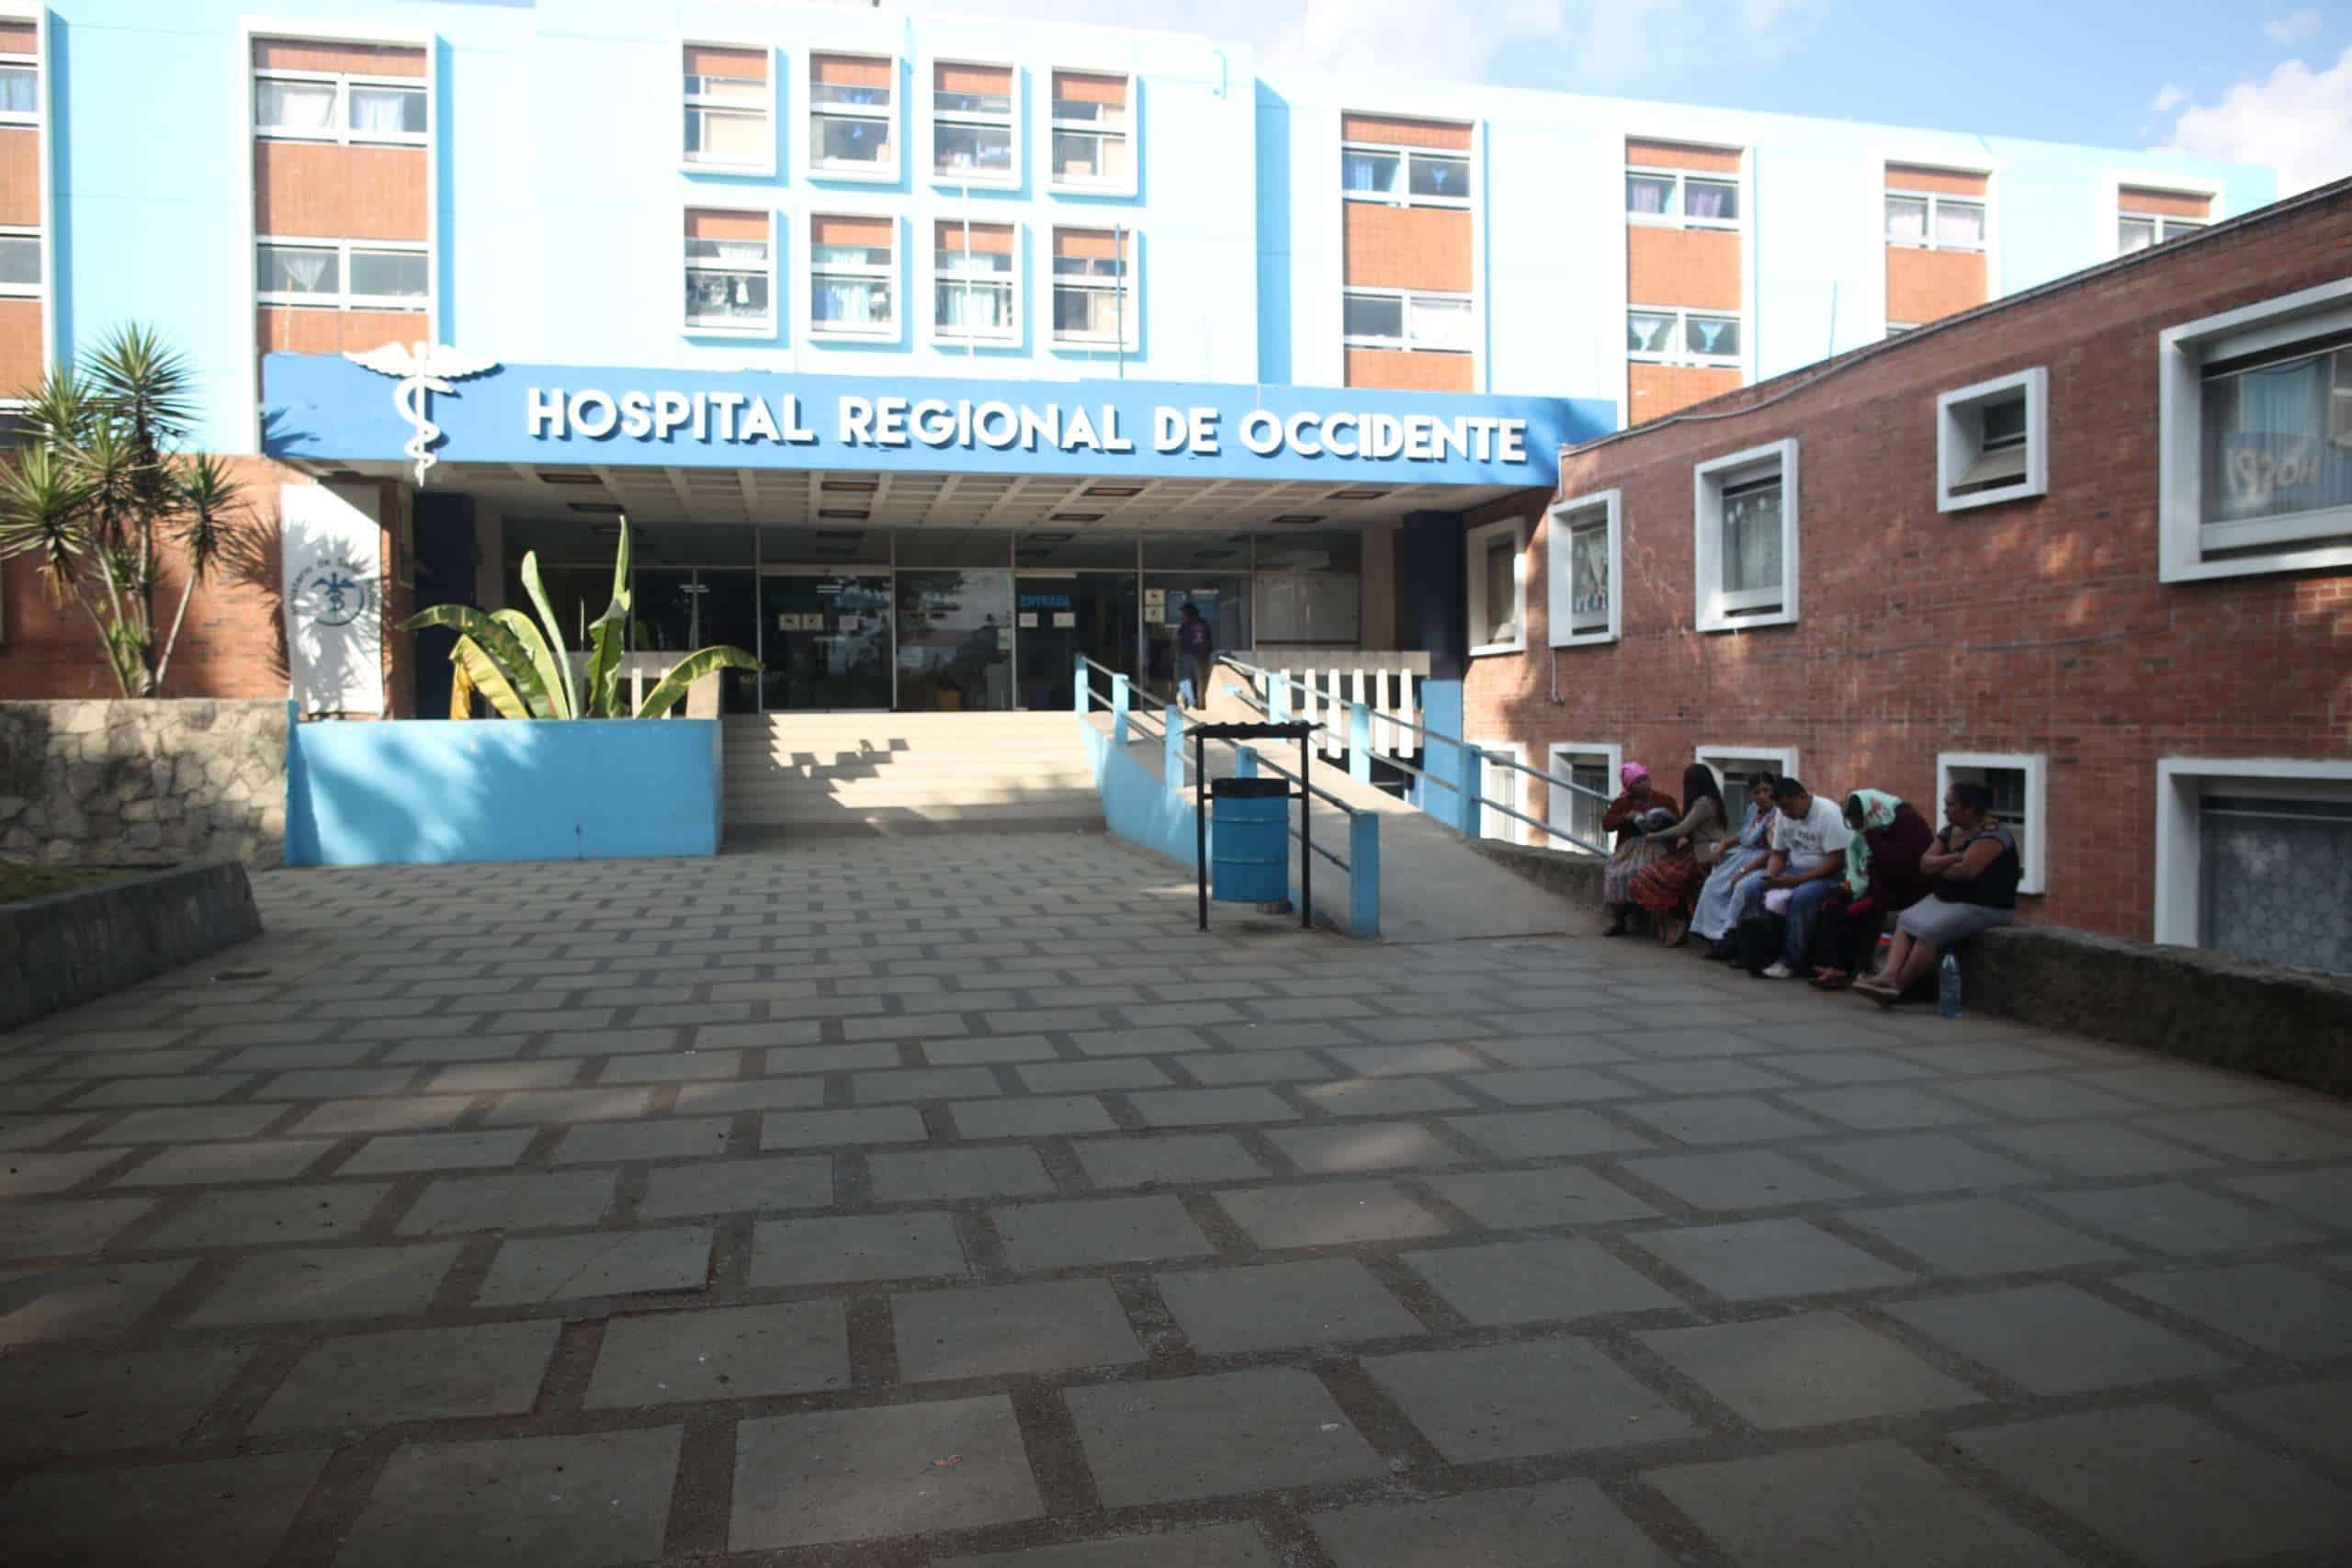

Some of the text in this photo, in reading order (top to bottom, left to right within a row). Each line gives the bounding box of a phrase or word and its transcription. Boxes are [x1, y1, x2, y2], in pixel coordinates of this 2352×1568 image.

[527, 387, 1527, 461] HOSPITAL REGIONAL DE OCCIDENTE
